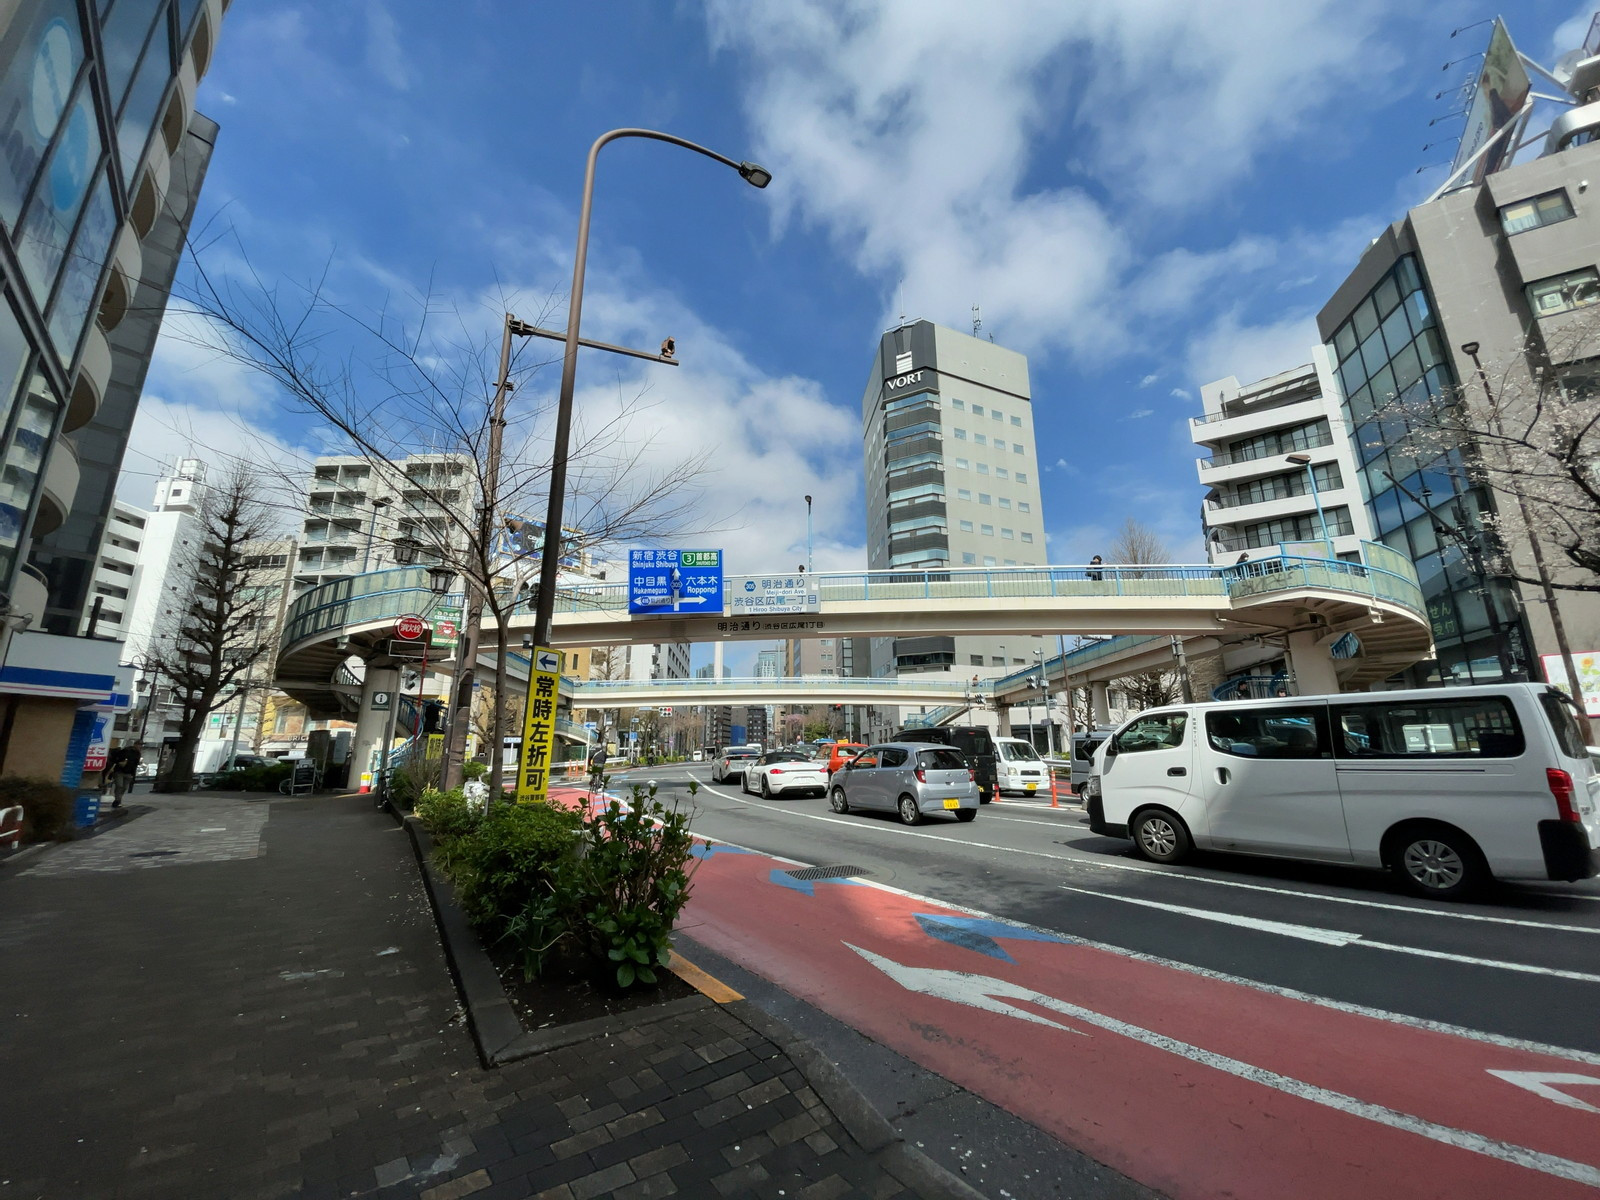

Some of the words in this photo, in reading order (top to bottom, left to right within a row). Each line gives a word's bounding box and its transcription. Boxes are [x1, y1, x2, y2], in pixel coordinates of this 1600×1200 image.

[887, 370, 924, 391] VORT
[632, 550, 654, 561] 新宿
[656, 550, 678, 561] 渋谷
[632, 561, 655, 569] Shinjuku
[656, 561, 678, 569] Shibuya
[634, 576, 667, 587] 中目黒
[686, 576, 718, 586] 六本木
[762, 579, 805, 589] 明治通り
[633, 587, 668, 595] Nakameguro
[687, 586, 717, 595] Roppongi
[734, 595, 817, 607] 渋谷区広尾一丁目
[400, 623, 421, 634] 消火栓
[717, 621, 760, 631] 明治通り
[1433, 620, 1455, 637] 受付
[526, 675, 555, 791] 常時左折可
[87, 746, 106, 755] ばこ
[83, 759, 103, 768] TM
